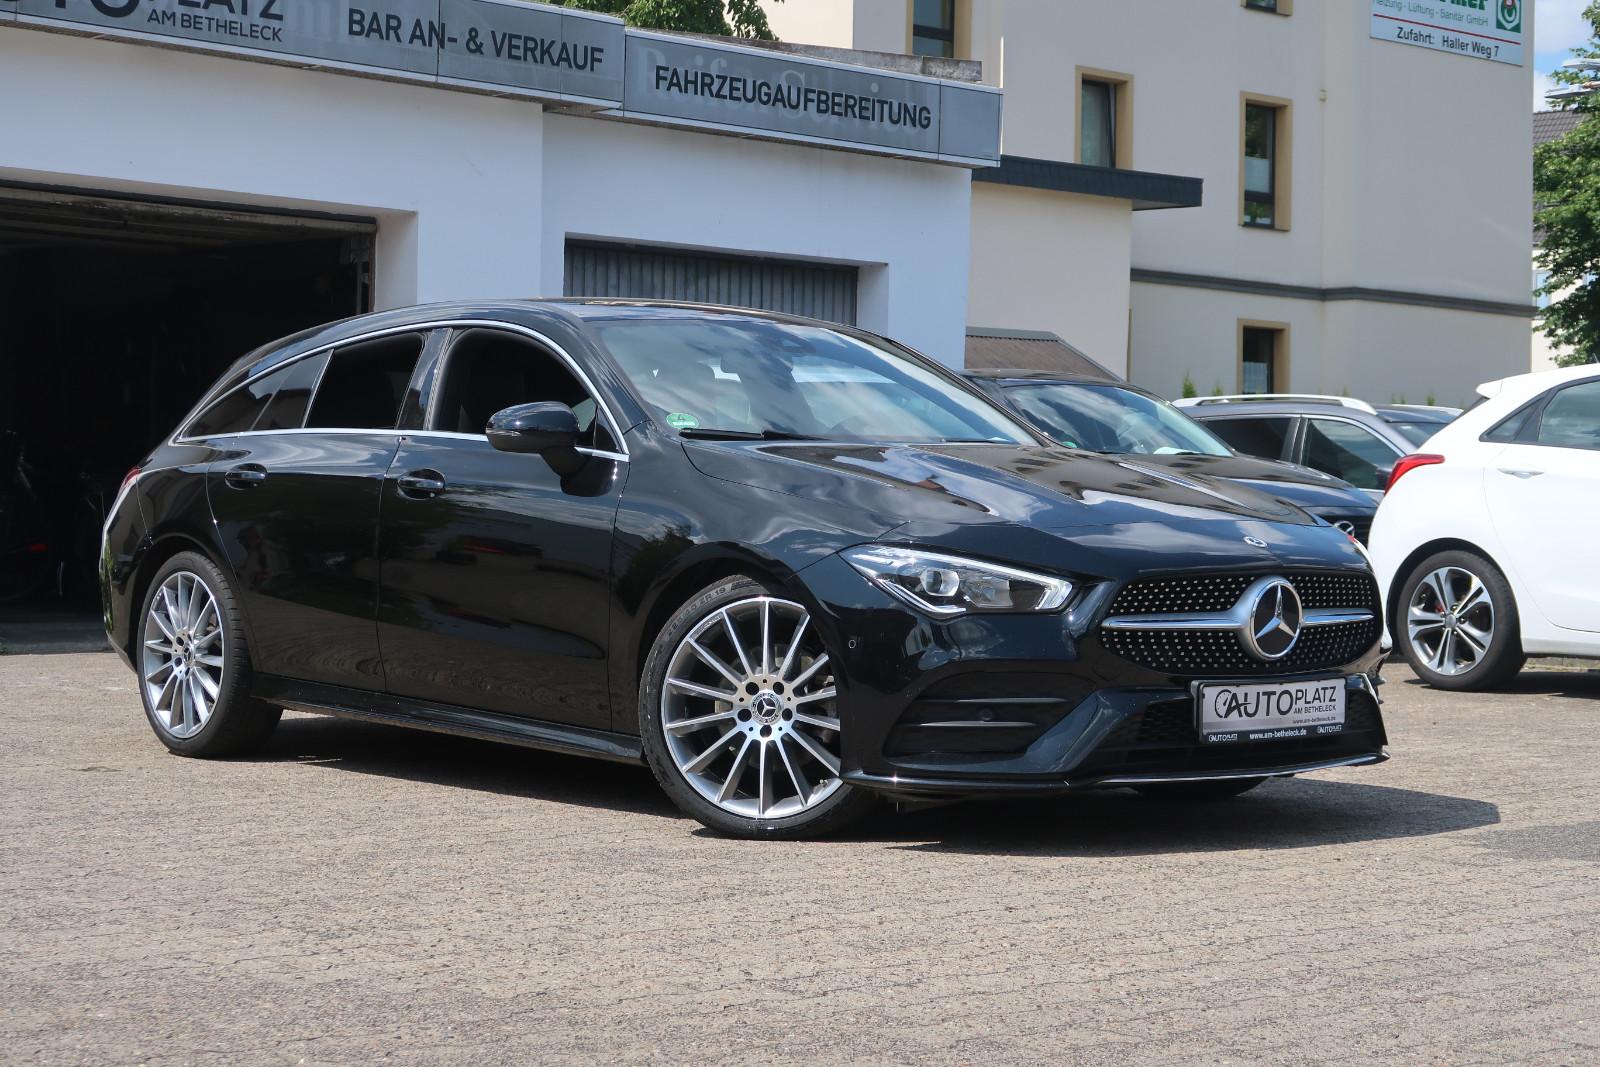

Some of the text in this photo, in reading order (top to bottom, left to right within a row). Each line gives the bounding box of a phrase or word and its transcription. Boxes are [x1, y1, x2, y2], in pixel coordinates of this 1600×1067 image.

[147, 9, 176, 27] AM
[181, 14, 282, 42] BETHELECK
[1466, 14, 1489, 27] GmbH
[348, 8, 402, 43] BAR
[408, 18, 458, 49] AN-
[465, 27, 485, 55] &
[491, 30, 604, 72] VERKAUF
[1397, 27, 1500, 58] Zufahrt: Haller Weg 7
[655, 64, 932, 130] FAHRZEUGAUFBEREITUNG
[1293, 704, 1336, 714] AM BETHELECK
